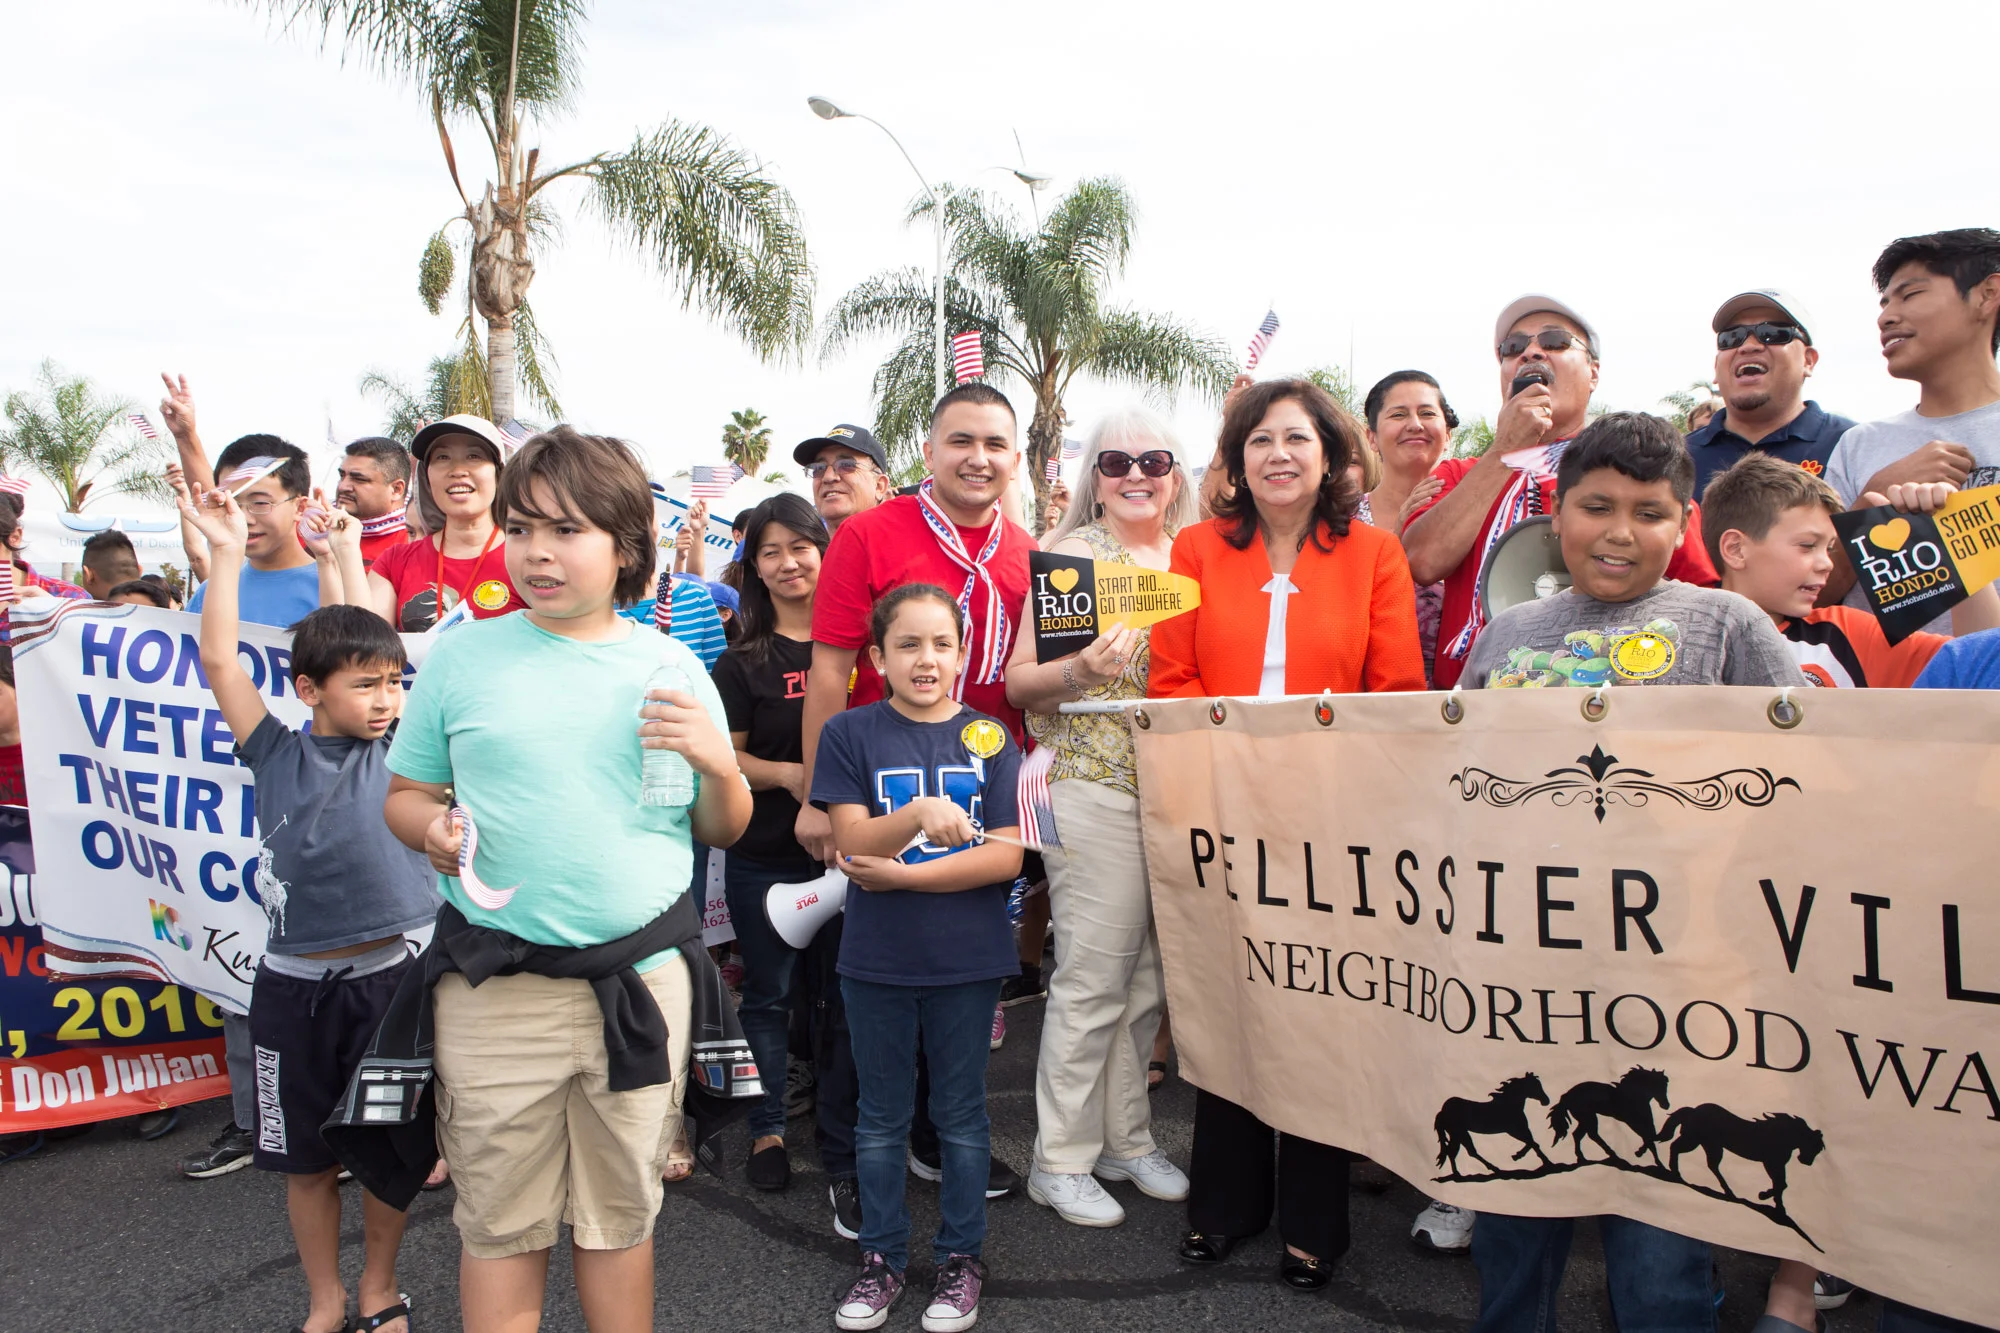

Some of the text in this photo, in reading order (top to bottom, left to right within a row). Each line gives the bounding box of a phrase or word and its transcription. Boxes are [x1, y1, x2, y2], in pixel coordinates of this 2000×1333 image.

[1939, 500, 1994, 538] START
[1851, 535, 1875, 565] I
[1950, 534, 1979, 561] GO
[1862, 541, 1942, 591] RIO
[1036, 573, 1049, 597] I
[1097, 574, 1169, 596] START RIO...
[1874, 566, 1951, 605] HONDO
[1881, 582, 1957, 615] www.riohondo.edu
[1037, 592, 1093, 619] RIO
[1099, 592, 1183, 615] GO ANYWHERE
[1040, 615, 1094, 631] HONDO
[1040, 629, 1094, 639] www.riohondo.edu
[59, 753, 225, 834] THEIR
[81, 820, 185, 894] OUR
[796, 894, 819, 911] PYLE
[1190, 827, 2000, 1006] PELLISSIER VIL
[52, 984, 225, 1041] 2016
[1241, 935, 2000, 1123] NEIGHBORHOOD WA
[11, 1065, 96, 1112] Don
[101, 1052, 219, 1098] Julian
[257, 1048, 285, 1152] BROOKLYN
